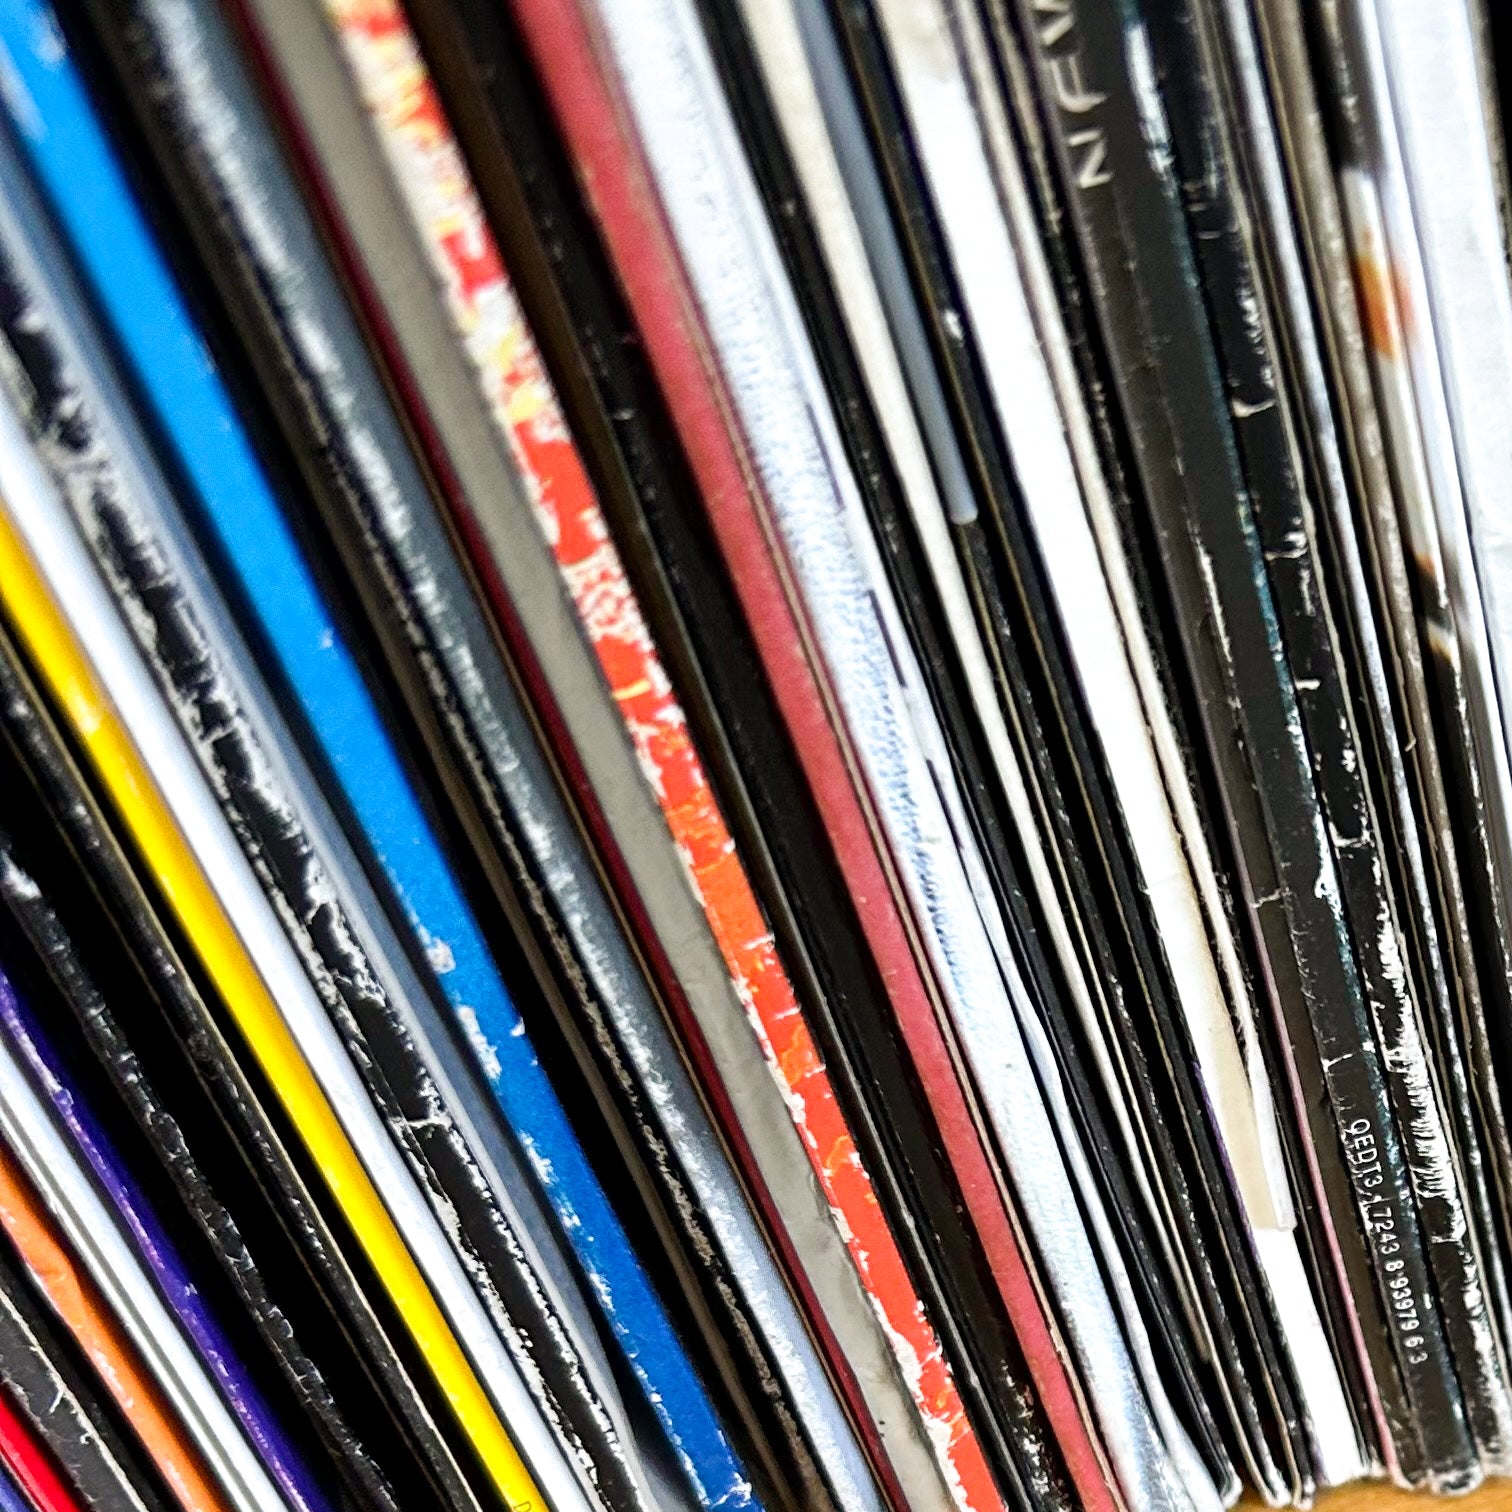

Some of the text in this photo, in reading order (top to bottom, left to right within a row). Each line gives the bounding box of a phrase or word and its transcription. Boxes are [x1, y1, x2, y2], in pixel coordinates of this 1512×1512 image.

[1349, 1118, 1429, 1364] QEDT3 7243 8 93979 6 3
